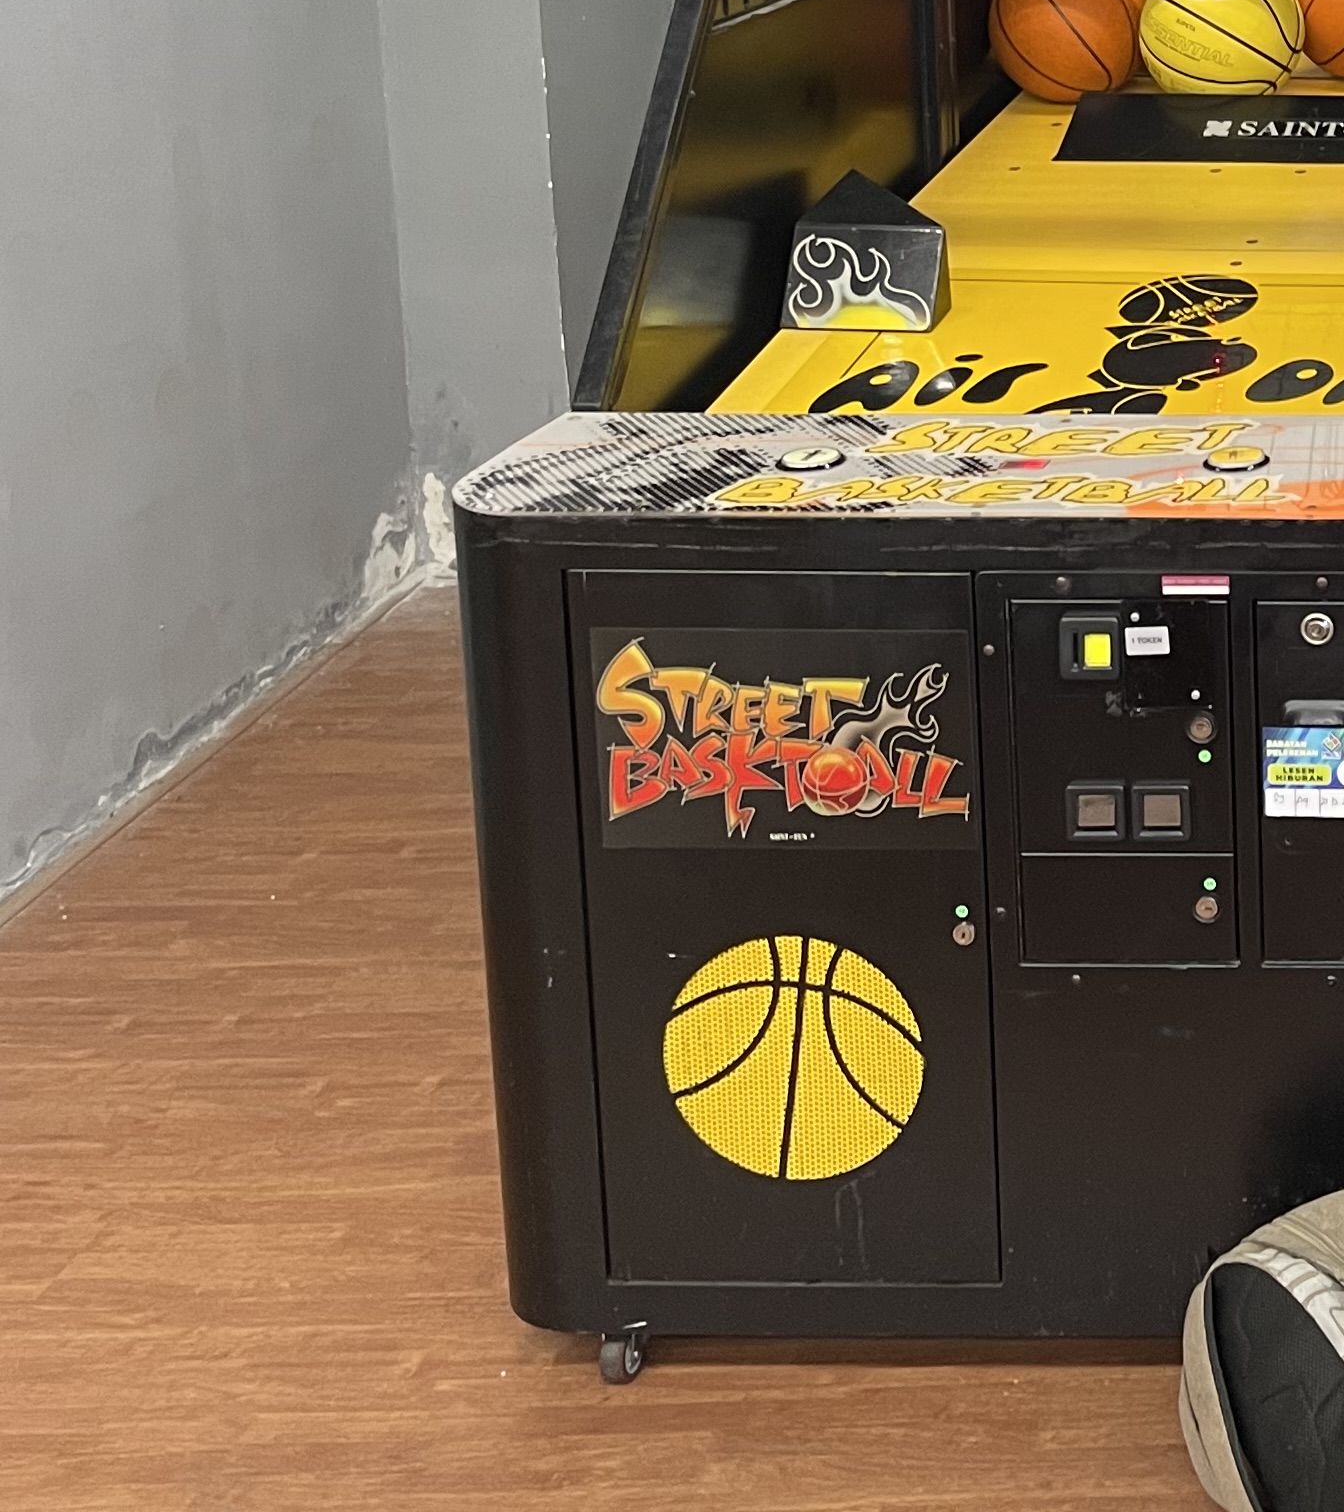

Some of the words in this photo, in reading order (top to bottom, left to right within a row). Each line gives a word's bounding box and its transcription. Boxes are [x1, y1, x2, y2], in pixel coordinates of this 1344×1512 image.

[866, 420, 1256, 457] STREET
[716, 477, 1288, 505] BASKETBALL
[1137, 637, 1163, 645] TOKEN
[596, 636, 870, 751] STREET
